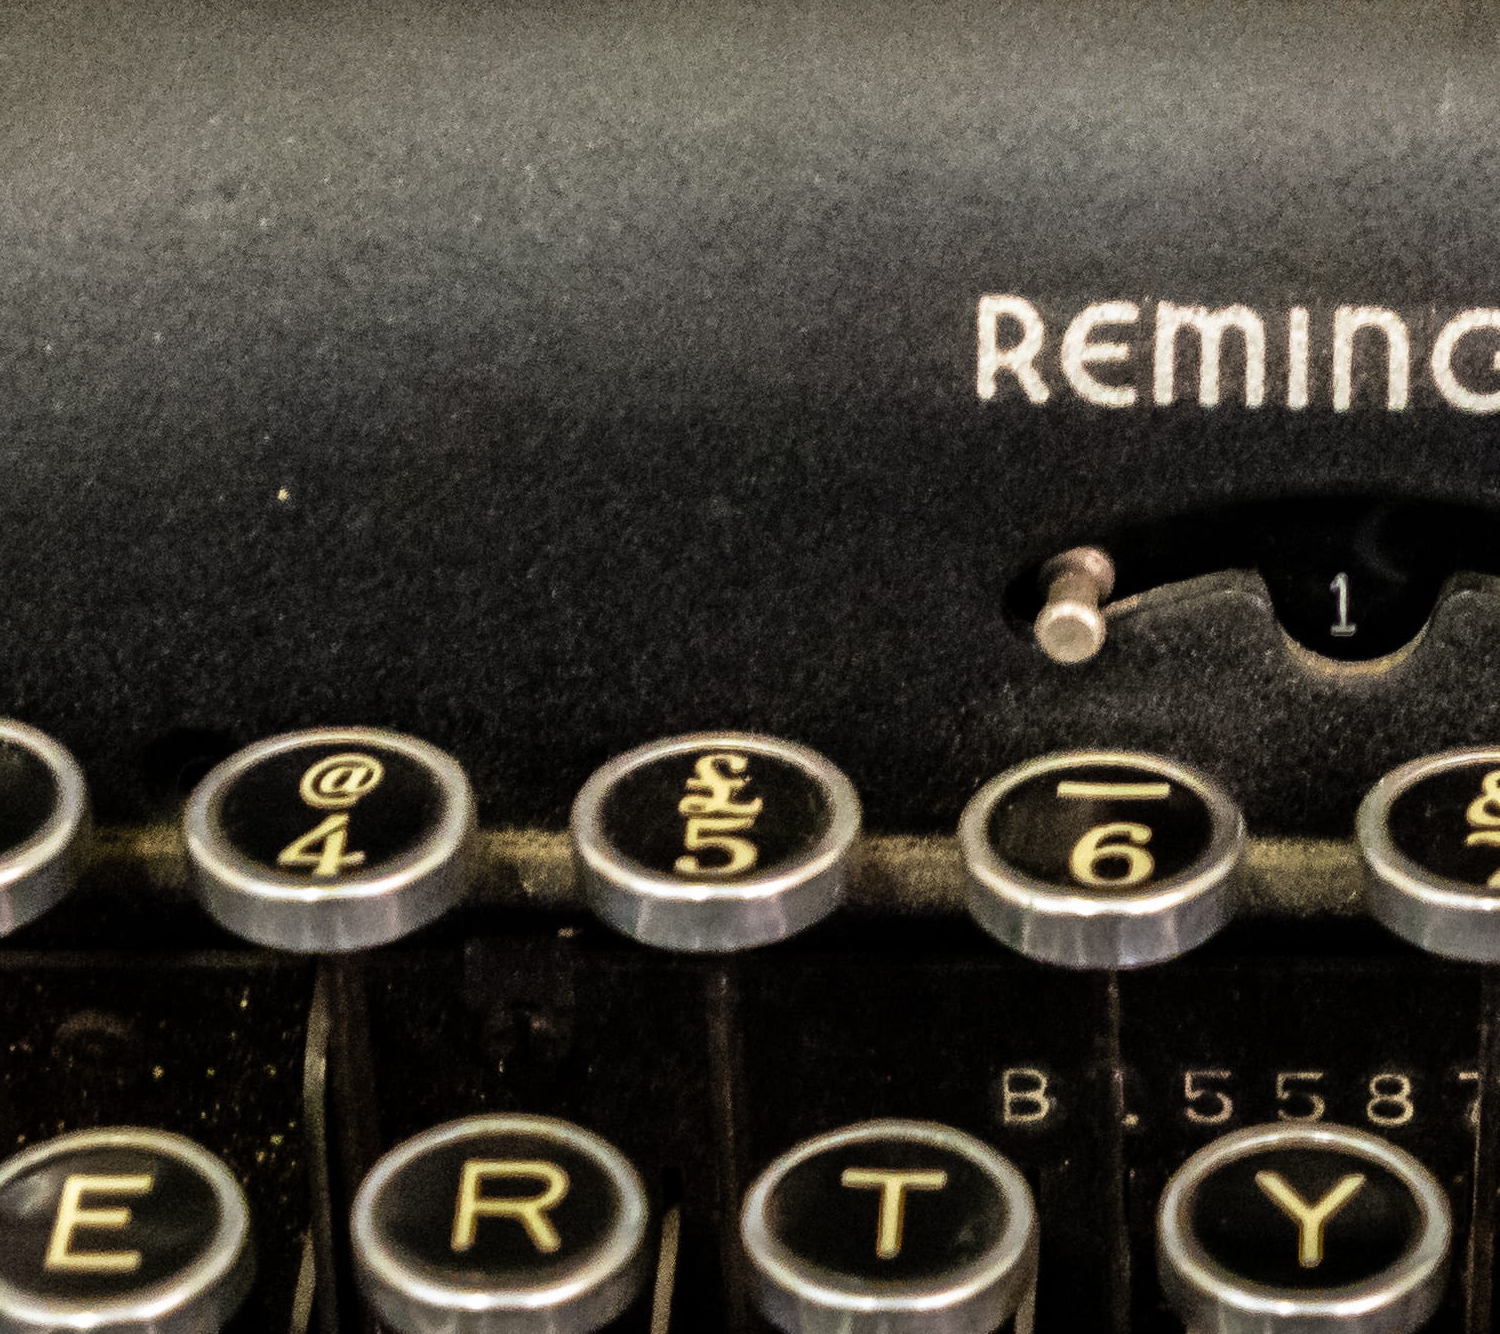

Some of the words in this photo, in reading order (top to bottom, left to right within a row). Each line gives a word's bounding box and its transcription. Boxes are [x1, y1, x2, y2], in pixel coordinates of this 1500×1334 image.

[1331, 573, 1355, 635] 1
[299, 753, 384, 808] @
[279, 813, 364, 879] 4
[676, 816, 759, 877] 5
[1070, 823, 1152, 885] 6
[46, 1173, 152, 1269] E
[450, 1160, 572, 1253] R
[842, 1169, 947, 1256] T
[1256, 1172, 1364, 1264] Y
